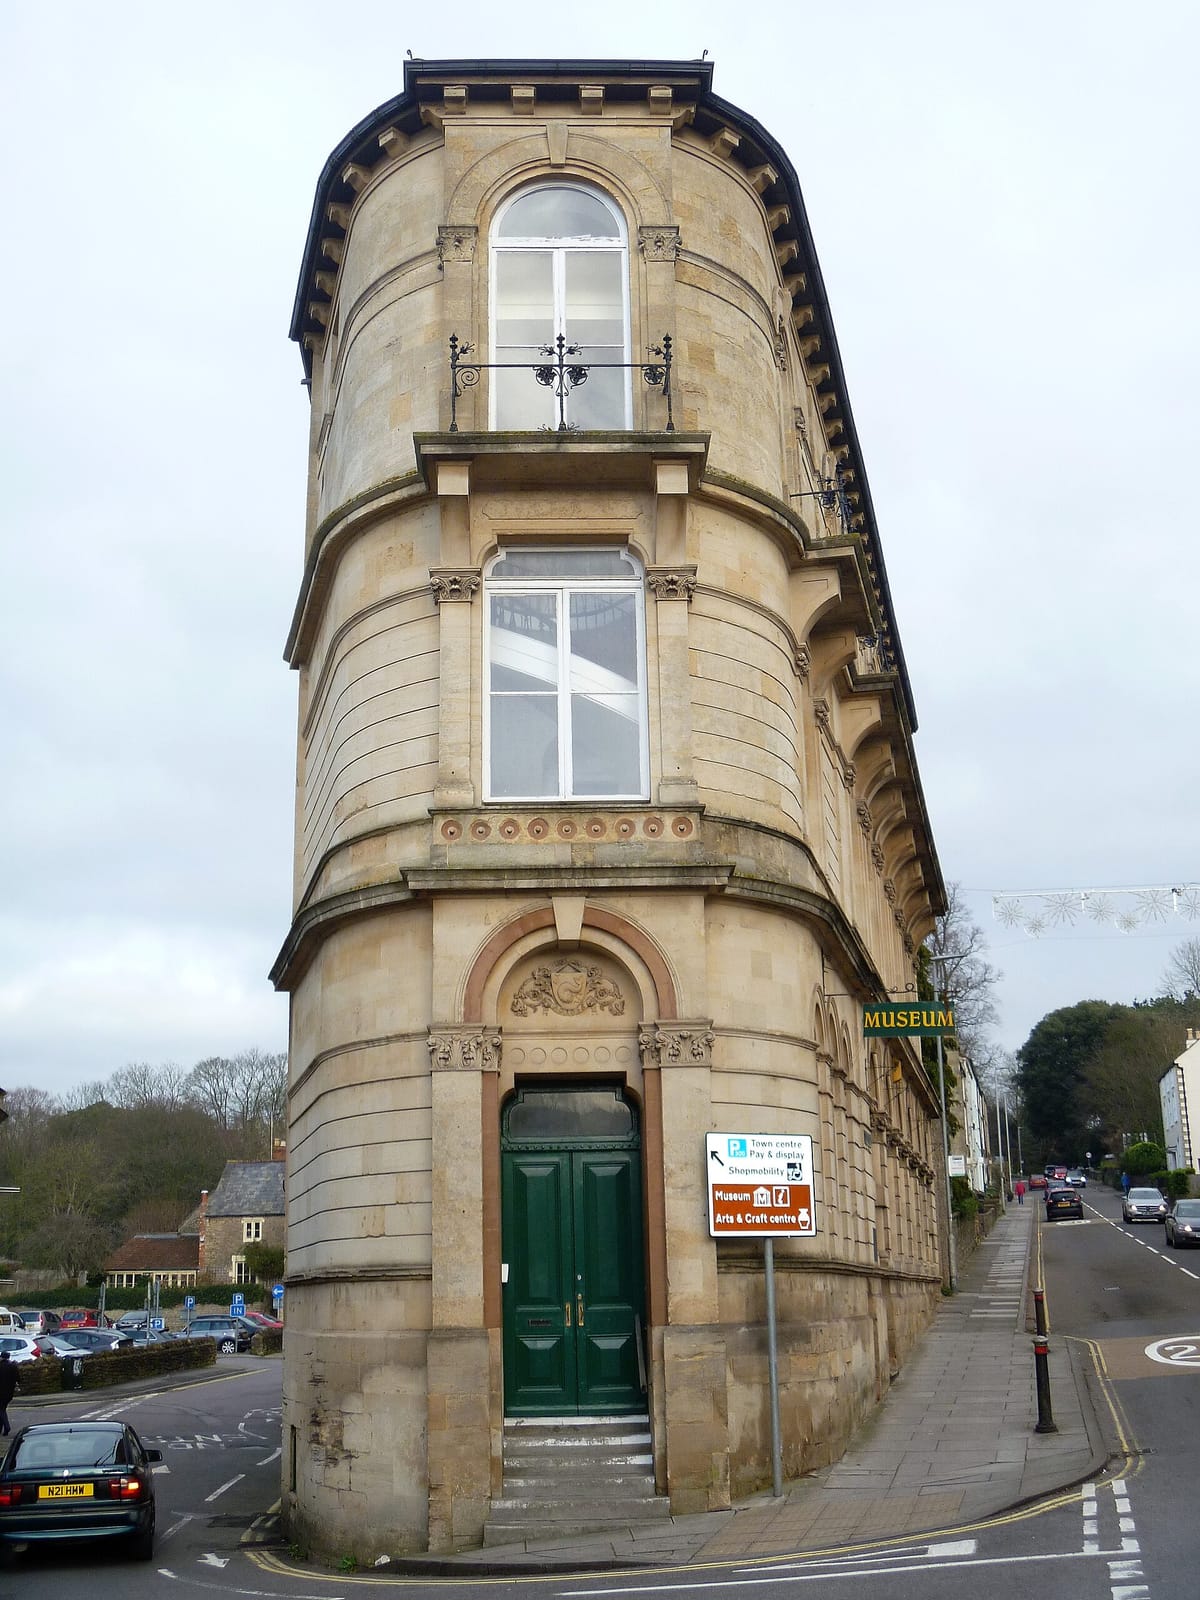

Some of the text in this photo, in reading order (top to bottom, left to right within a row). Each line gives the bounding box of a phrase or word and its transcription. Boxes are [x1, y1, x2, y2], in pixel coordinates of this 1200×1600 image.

[864, 1010, 955, 1028] MUSEUM
[751, 1139, 802, 1149] Town centre
[749, 1150, 765, 1160] Pay
[767, 1150, 773, 1159] &
[775, 1150, 805, 1160] display
[728, 1166, 785, 1176] Shopmobility
[715, 1190, 751, 1201] Museum
[715, 1212, 797, 1224] Arts & Craft centre
[187, 1297, 194, 1308] P
[235, 1295, 242, 1305] P
[233, 1306, 243, 1315] IN
